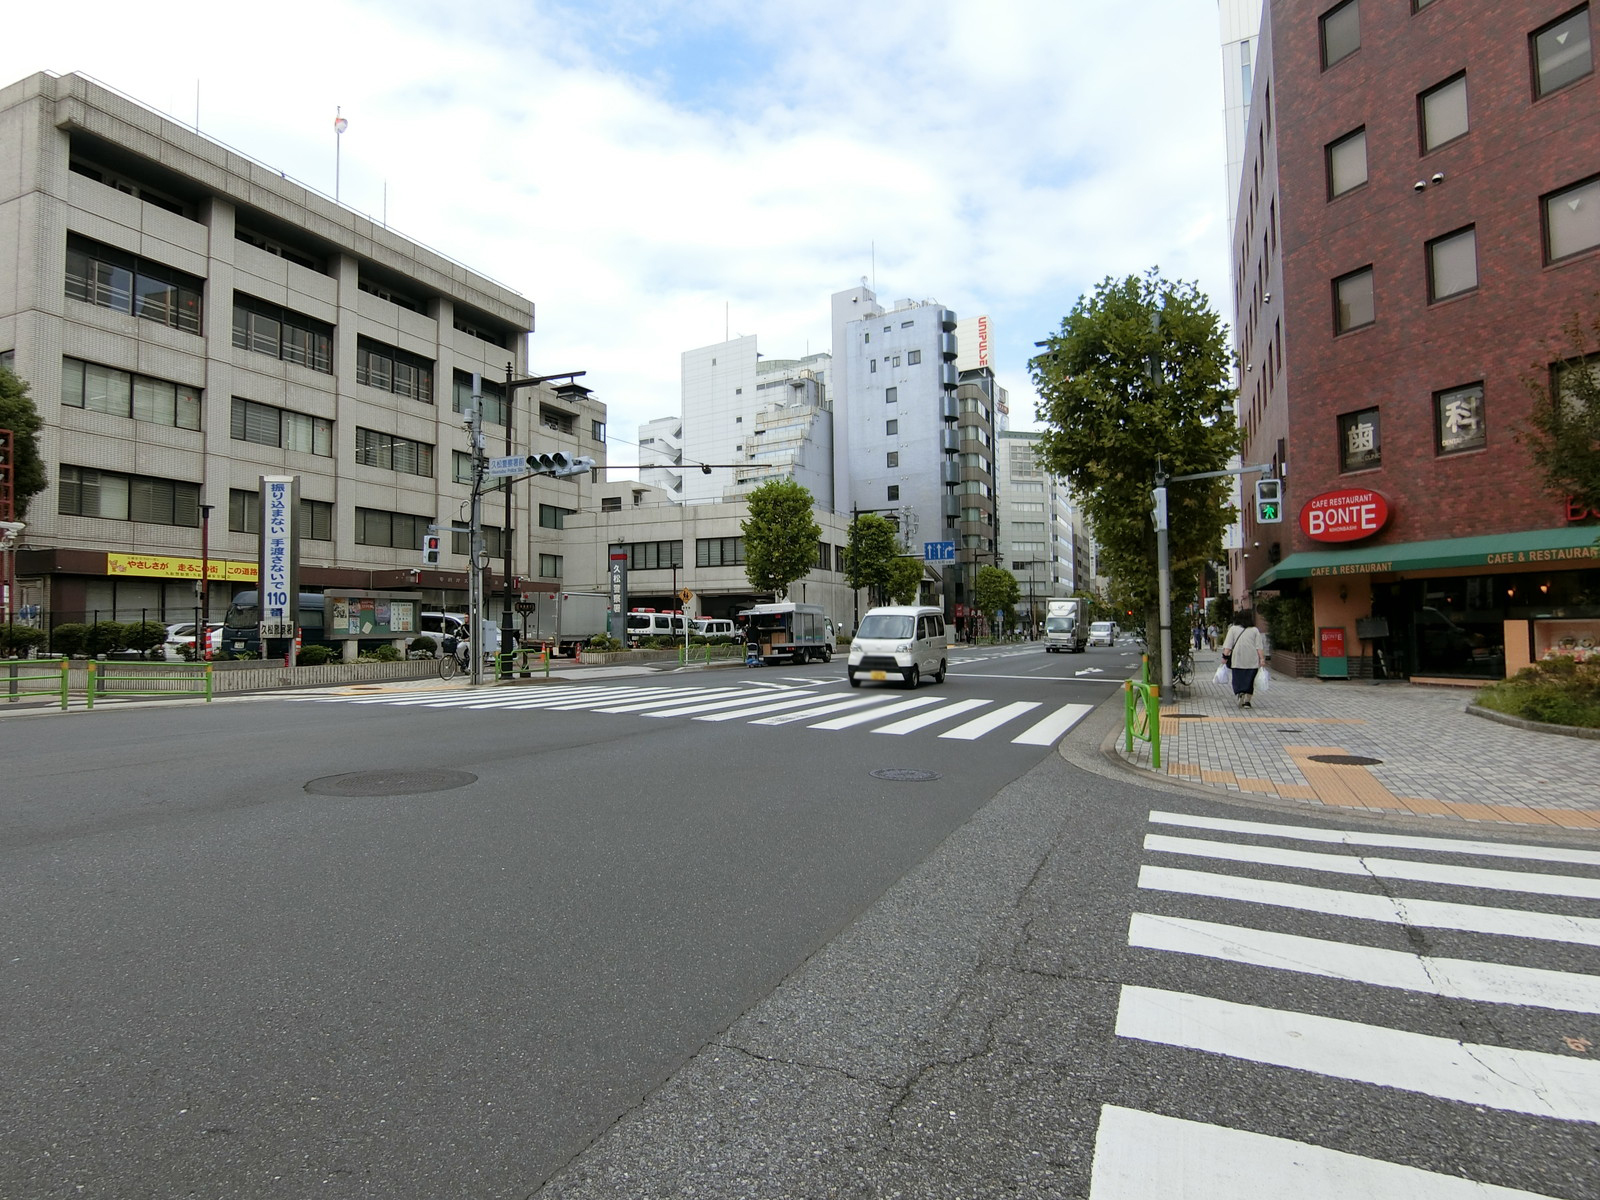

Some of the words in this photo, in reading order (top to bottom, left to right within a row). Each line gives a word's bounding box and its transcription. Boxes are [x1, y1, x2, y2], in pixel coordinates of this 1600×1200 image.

[978, 316, 988, 367] UNIPULSE
[1445, 396, 1479, 434] 科
[1348, 422, 1374, 453] 歯
[270, 483, 285, 533] 振り込まない
[1311, 499, 1328, 509] CAFE
[1329, 493, 1373, 506] RESTAURANT
[1309, 503, 1376, 535] BONTE
[1328, 525, 1357, 533] NIHONBASHI
[127, 560, 169, 570] やさしさが
[1487, 551, 1514, 565] CAFE
[1517, 551, 1525, 562] &
[1529, 547, 1600, 561] RESTAURAN
[1311, 566, 1330, 577] CAFE
[1332, 565, 1338, 575] &
[1340, 562, 1393, 574] RESTAURANT
[613, 564, 621, 613] 久松警察署
[260, 624, 293, 636] 久松警察署
